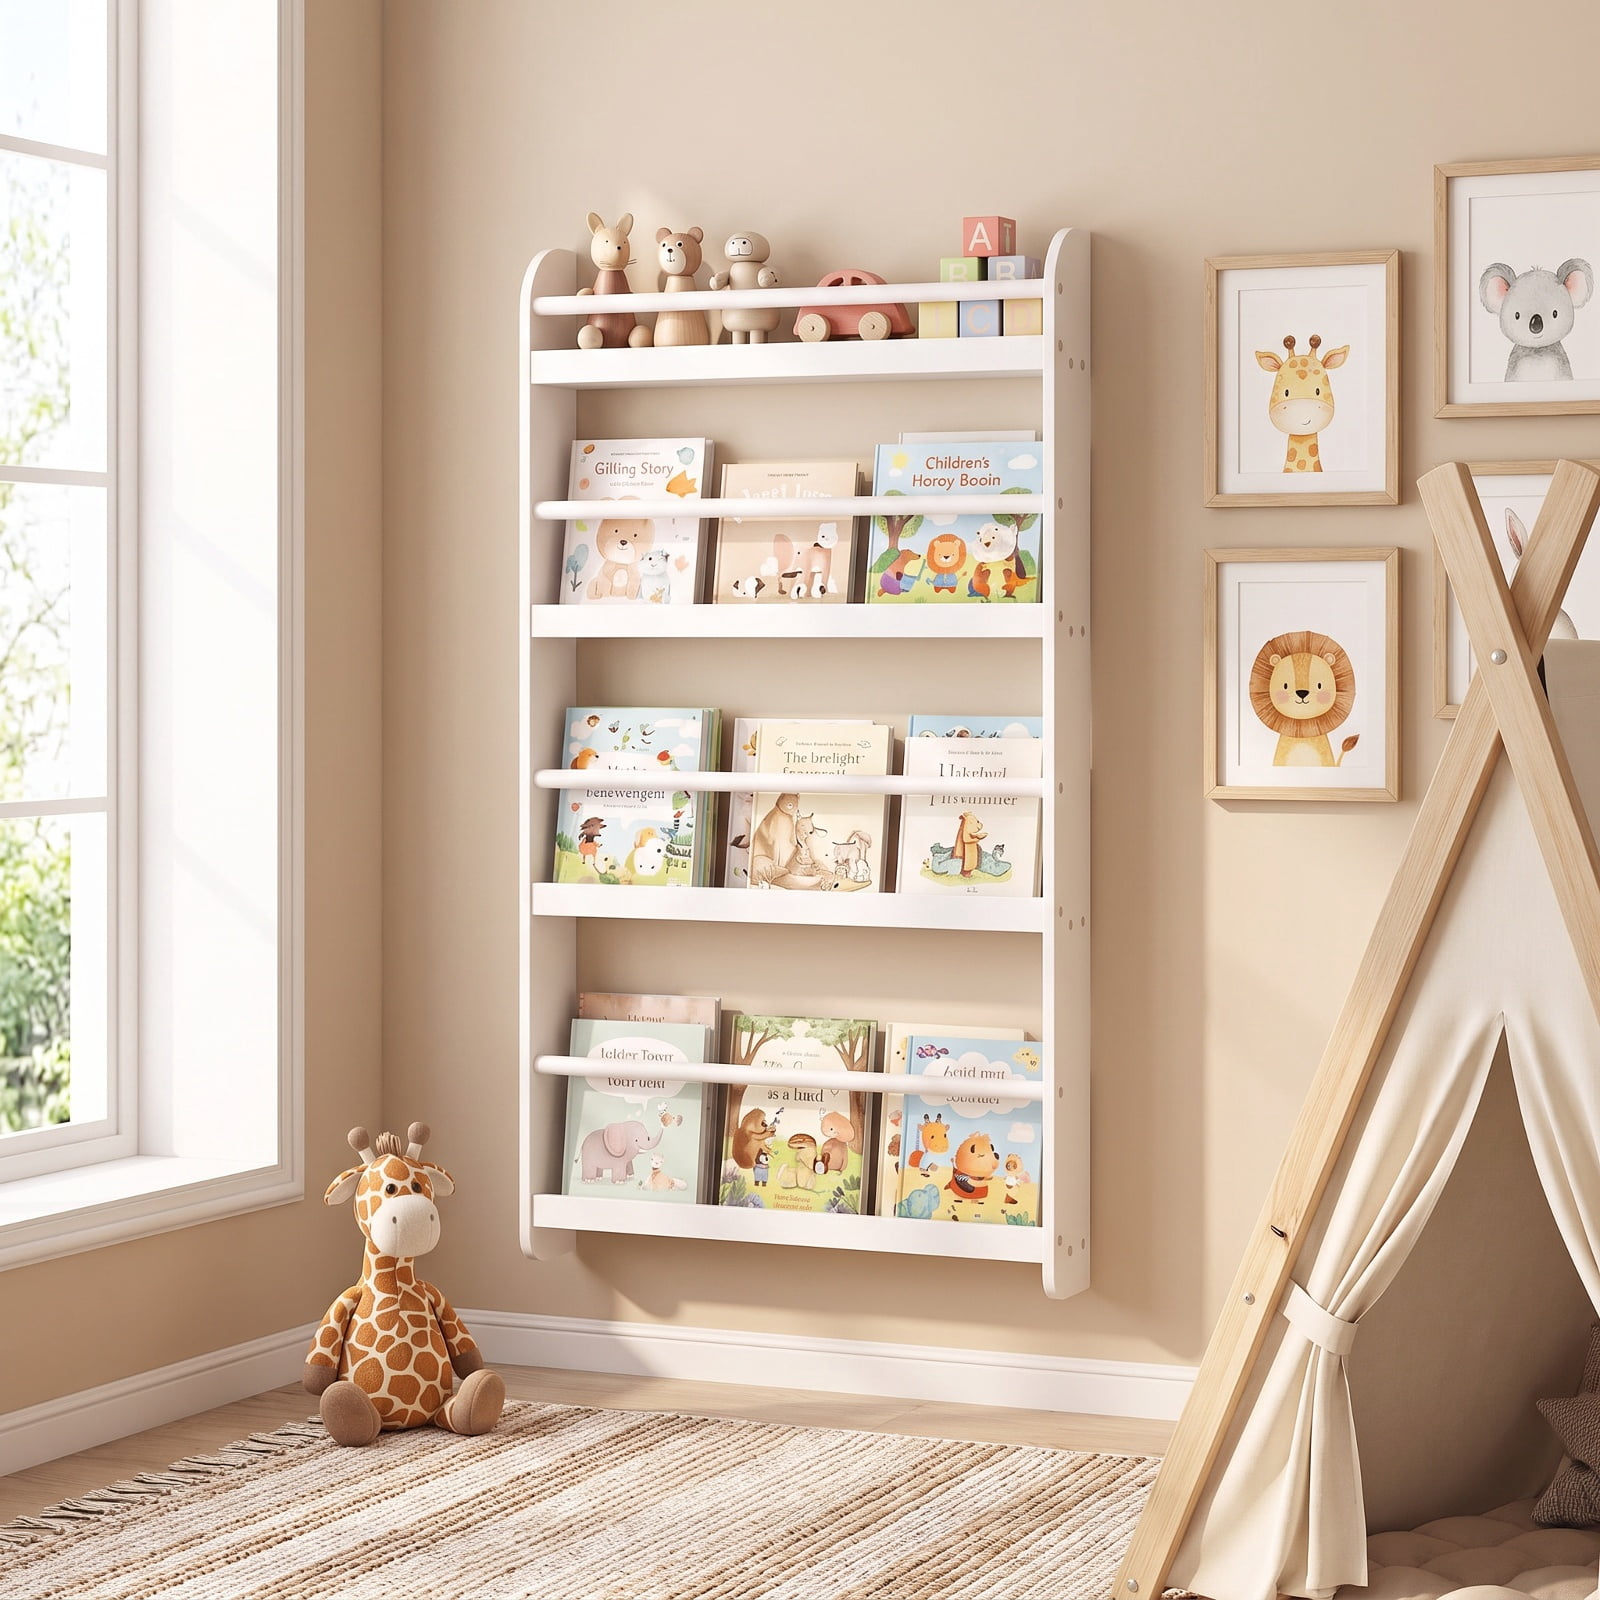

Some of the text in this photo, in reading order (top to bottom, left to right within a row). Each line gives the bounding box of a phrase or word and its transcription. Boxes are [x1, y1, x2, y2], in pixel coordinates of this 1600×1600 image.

[968, 221, 993, 252] A
[996, 261, 1016, 281] B
[966, 304, 991, 334] C
[594, 461, 674, 478] Gilling Story
[925, 456, 990, 470] Children's
[912, 473, 1001, 491] Horoy Booin
[783, 751, 807, 764] The
